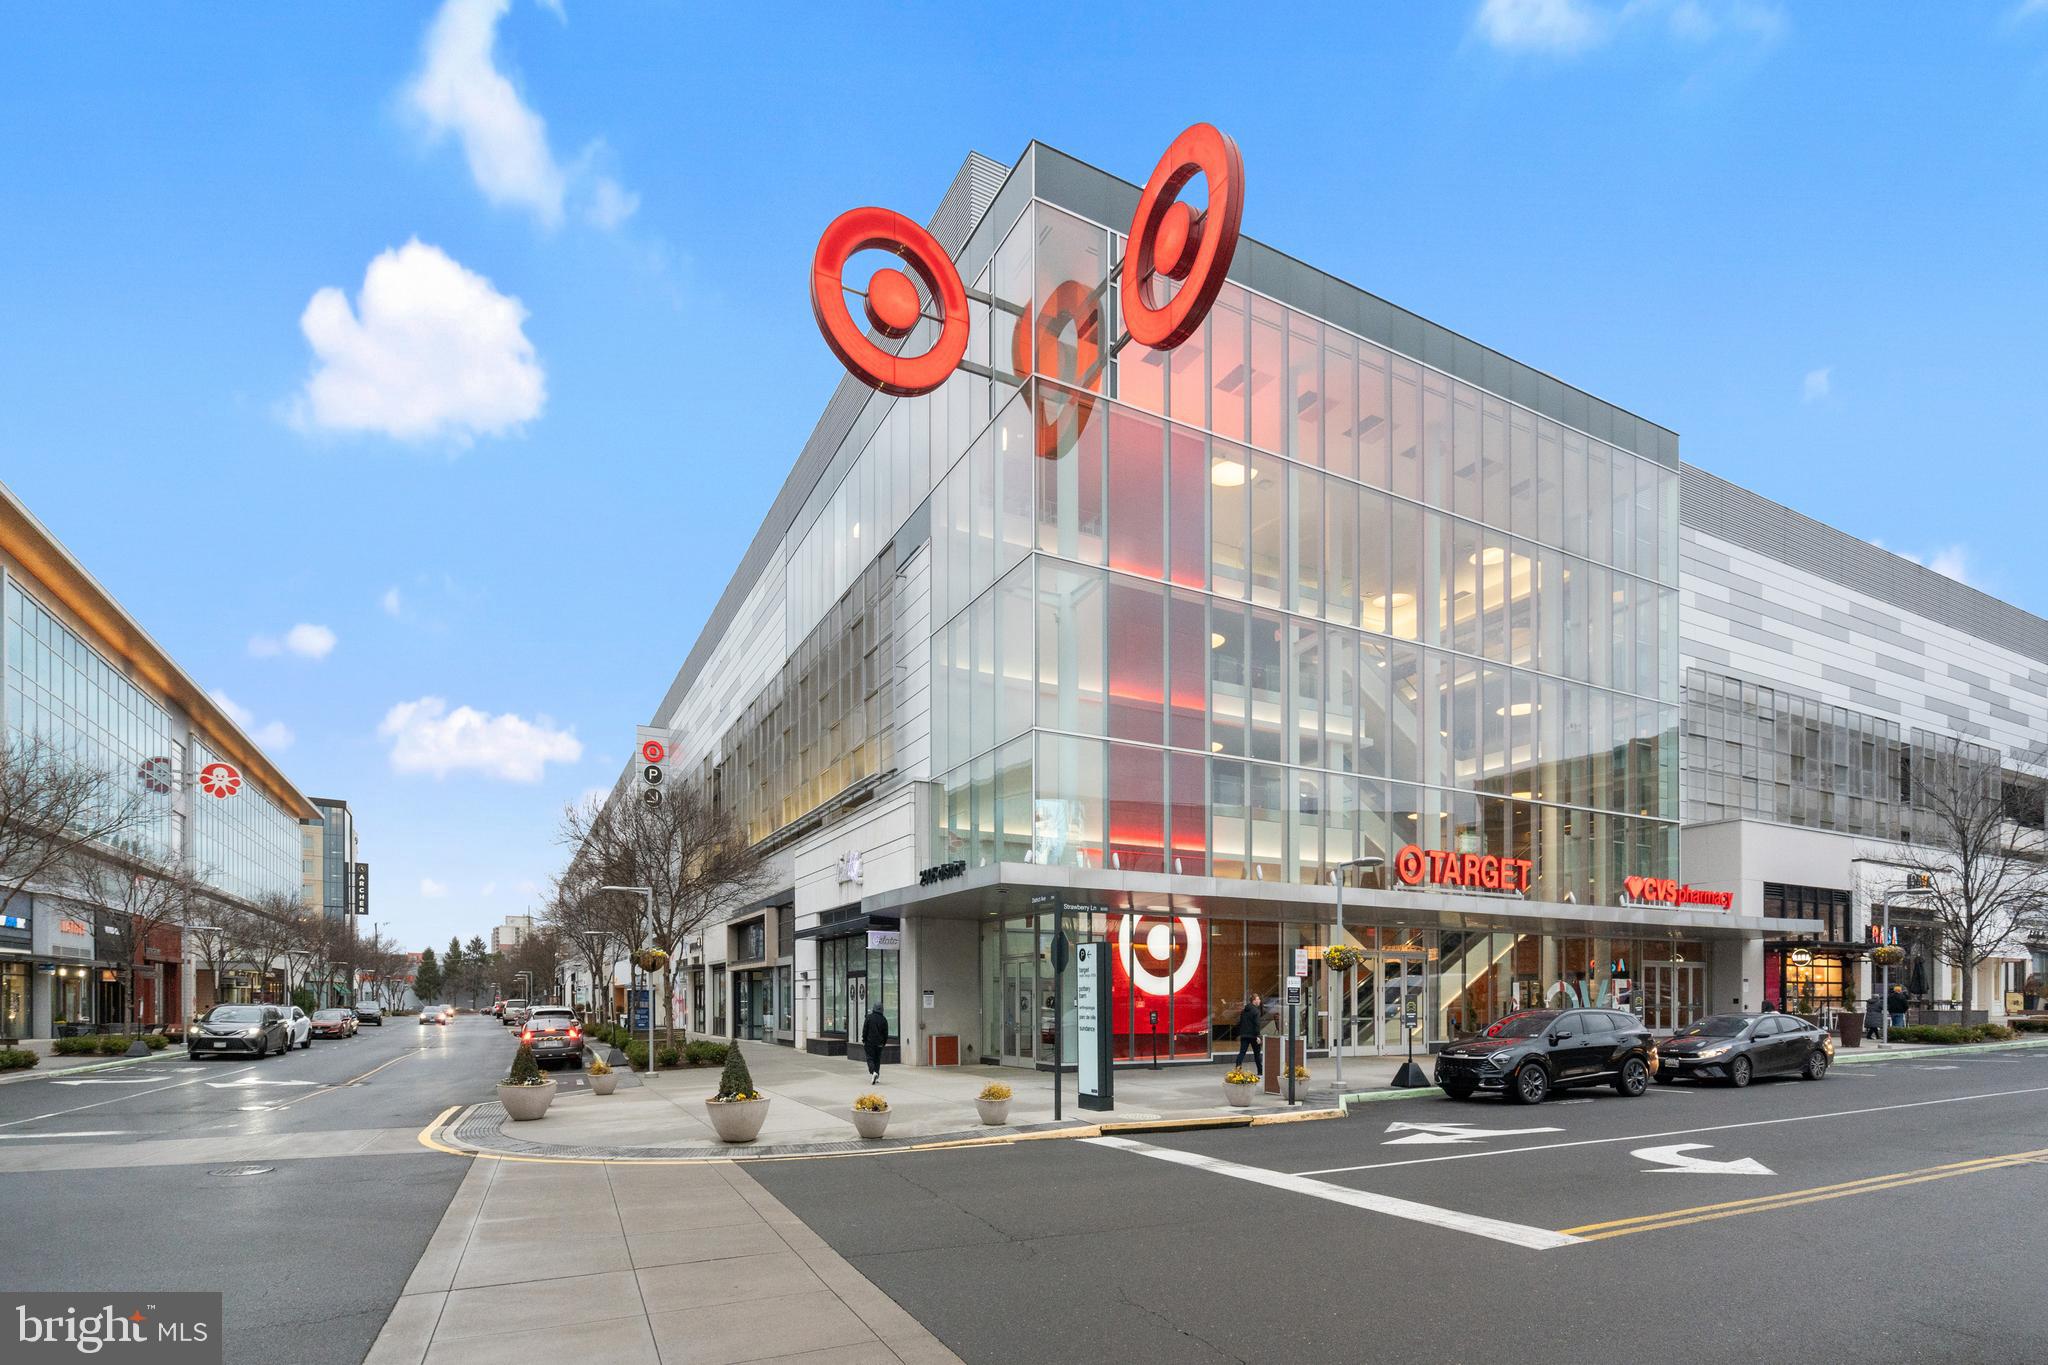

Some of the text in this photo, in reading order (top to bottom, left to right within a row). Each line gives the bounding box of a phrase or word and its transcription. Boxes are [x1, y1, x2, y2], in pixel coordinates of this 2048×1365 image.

[648, 768, 659, 780] P
[1423, 849, 1533, 893] TARGET
[1643, 877, 1735, 911] CVS pharmacy
[1063, 903, 1090, 912] Strawberry
